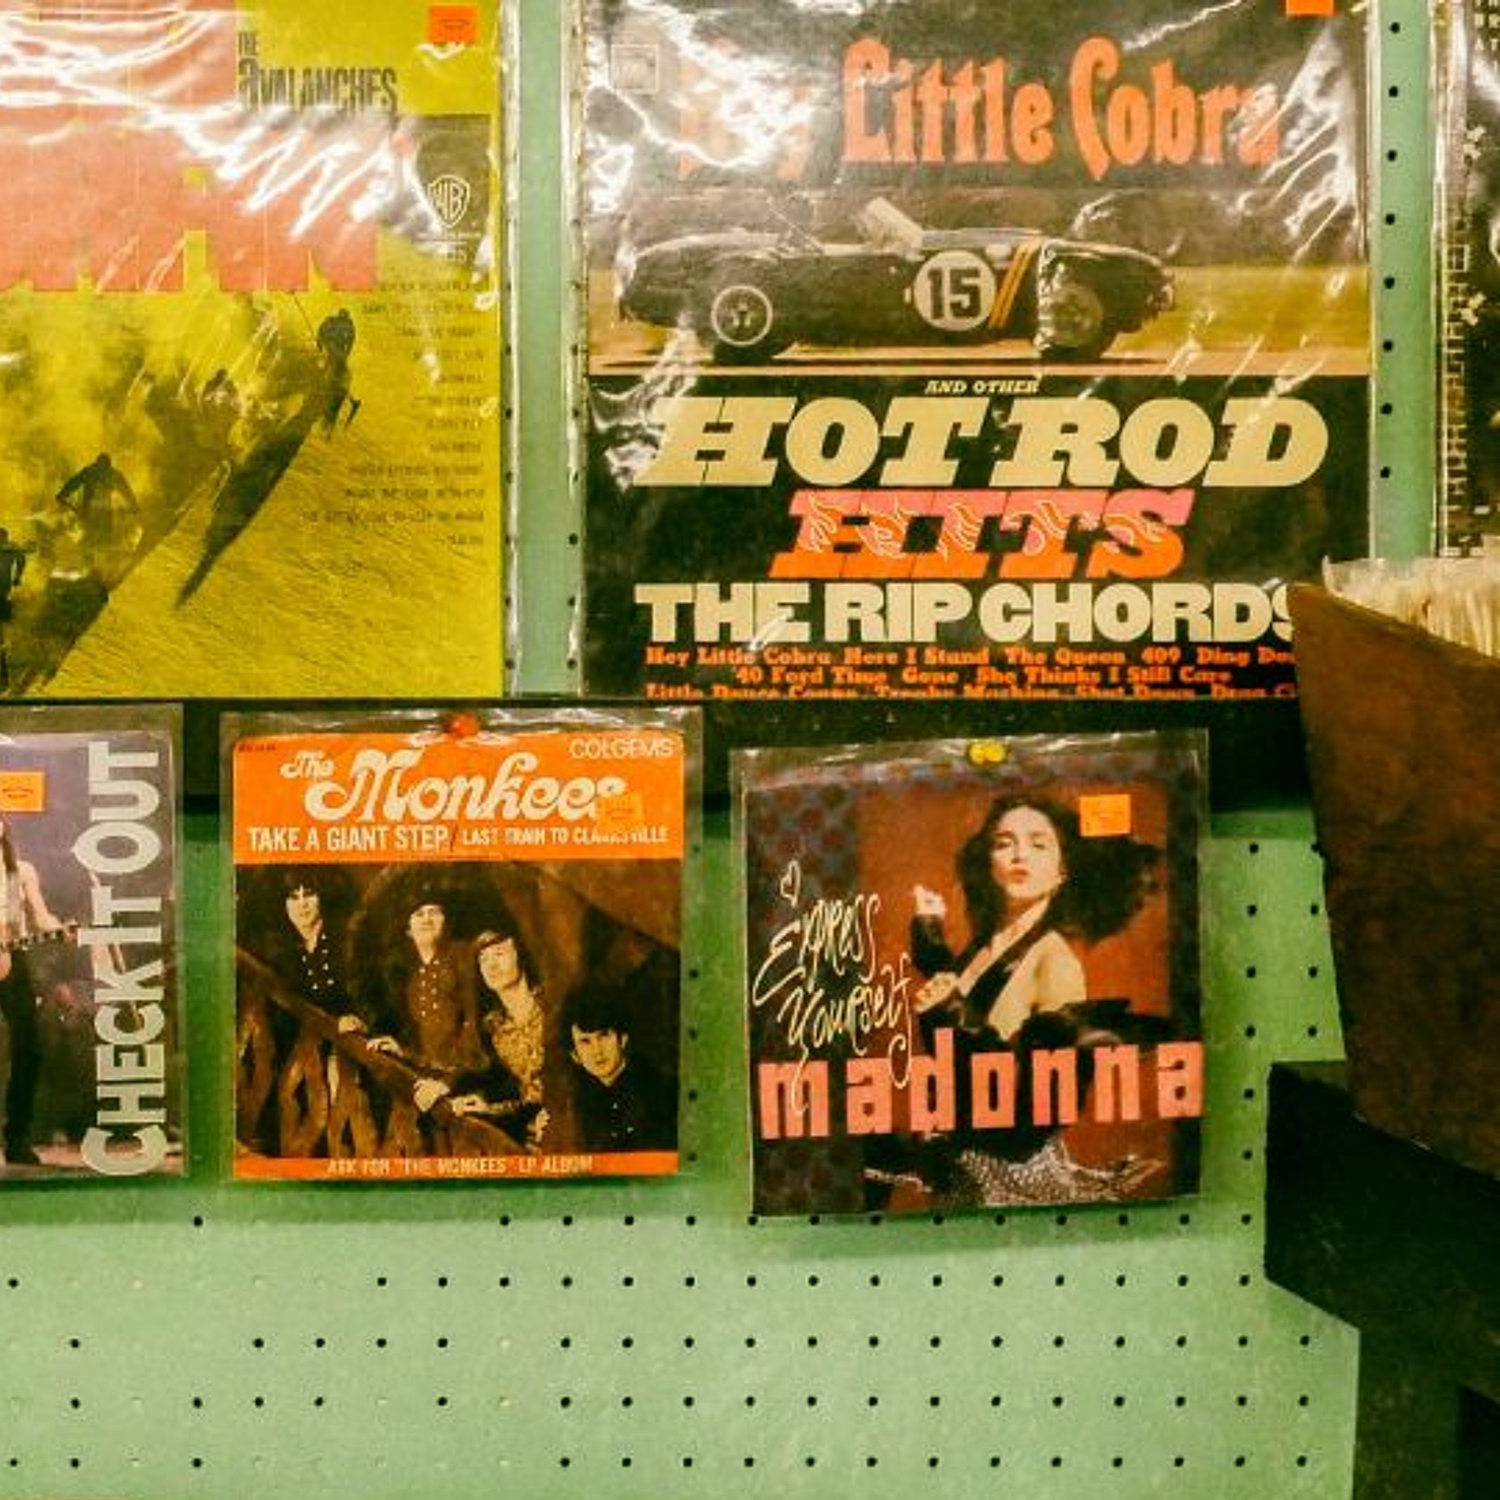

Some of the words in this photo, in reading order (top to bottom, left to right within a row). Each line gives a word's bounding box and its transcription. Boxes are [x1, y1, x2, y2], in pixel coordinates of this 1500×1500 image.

[842, 37, 1054, 165] Little
[1070, 37, 1282, 180] Cobra
[925, 267, 982, 320] 15
[925, 380, 968, 394] AND
[973, 379, 1039, 394] OTHER
[633, 395, 990, 488] HOT
[989, 395, 1329, 488] ROD
[768, 488, 1194, 579] HITS
[634, 583, 810, 642] THE
[823, 583, 973, 642] RIP
[1004, 647, 1047, 665] The
[280, 750, 336, 779] The
[72, 741, 163, 875] OUT
[549, 825, 567, 845] TO
[247, 827, 301, 852] TAKE
[306, 827, 318, 850] A
[328, 825, 390, 852] GIANT
[77, 886, 163, 946] IT
[80, 961, 168, 1177] CHECK
[758, 1026, 1205, 1139] madonna
